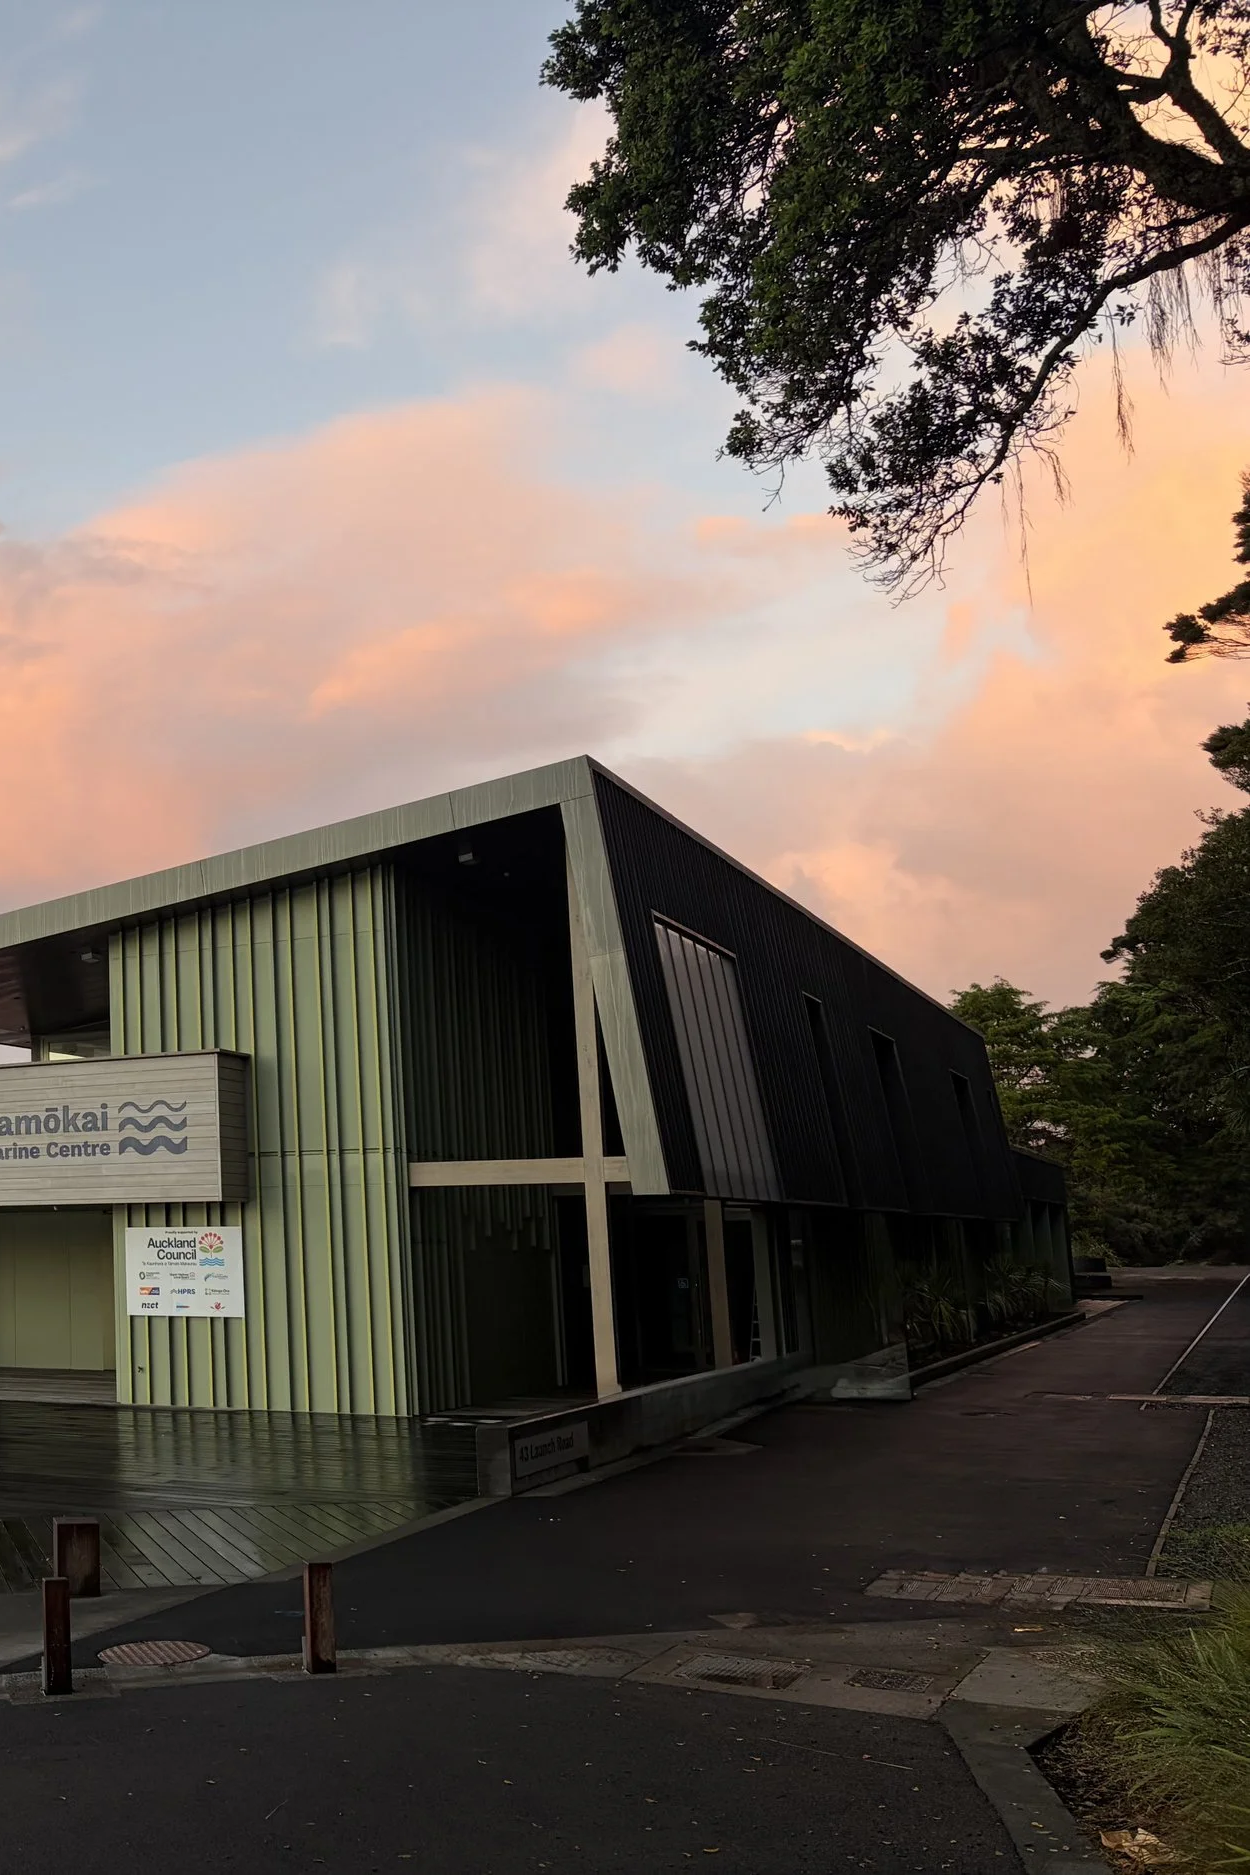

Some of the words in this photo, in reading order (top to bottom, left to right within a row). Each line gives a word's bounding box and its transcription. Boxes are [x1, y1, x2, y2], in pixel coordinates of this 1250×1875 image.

[46, 1140, 111, 1158] Centre
[147, 1237, 196, 1249] Auckland
[157, 1249, 196, 1260] Council
[531, 1437, 555, 1460] Launch
[557, 1432, 574, 1452] Road
